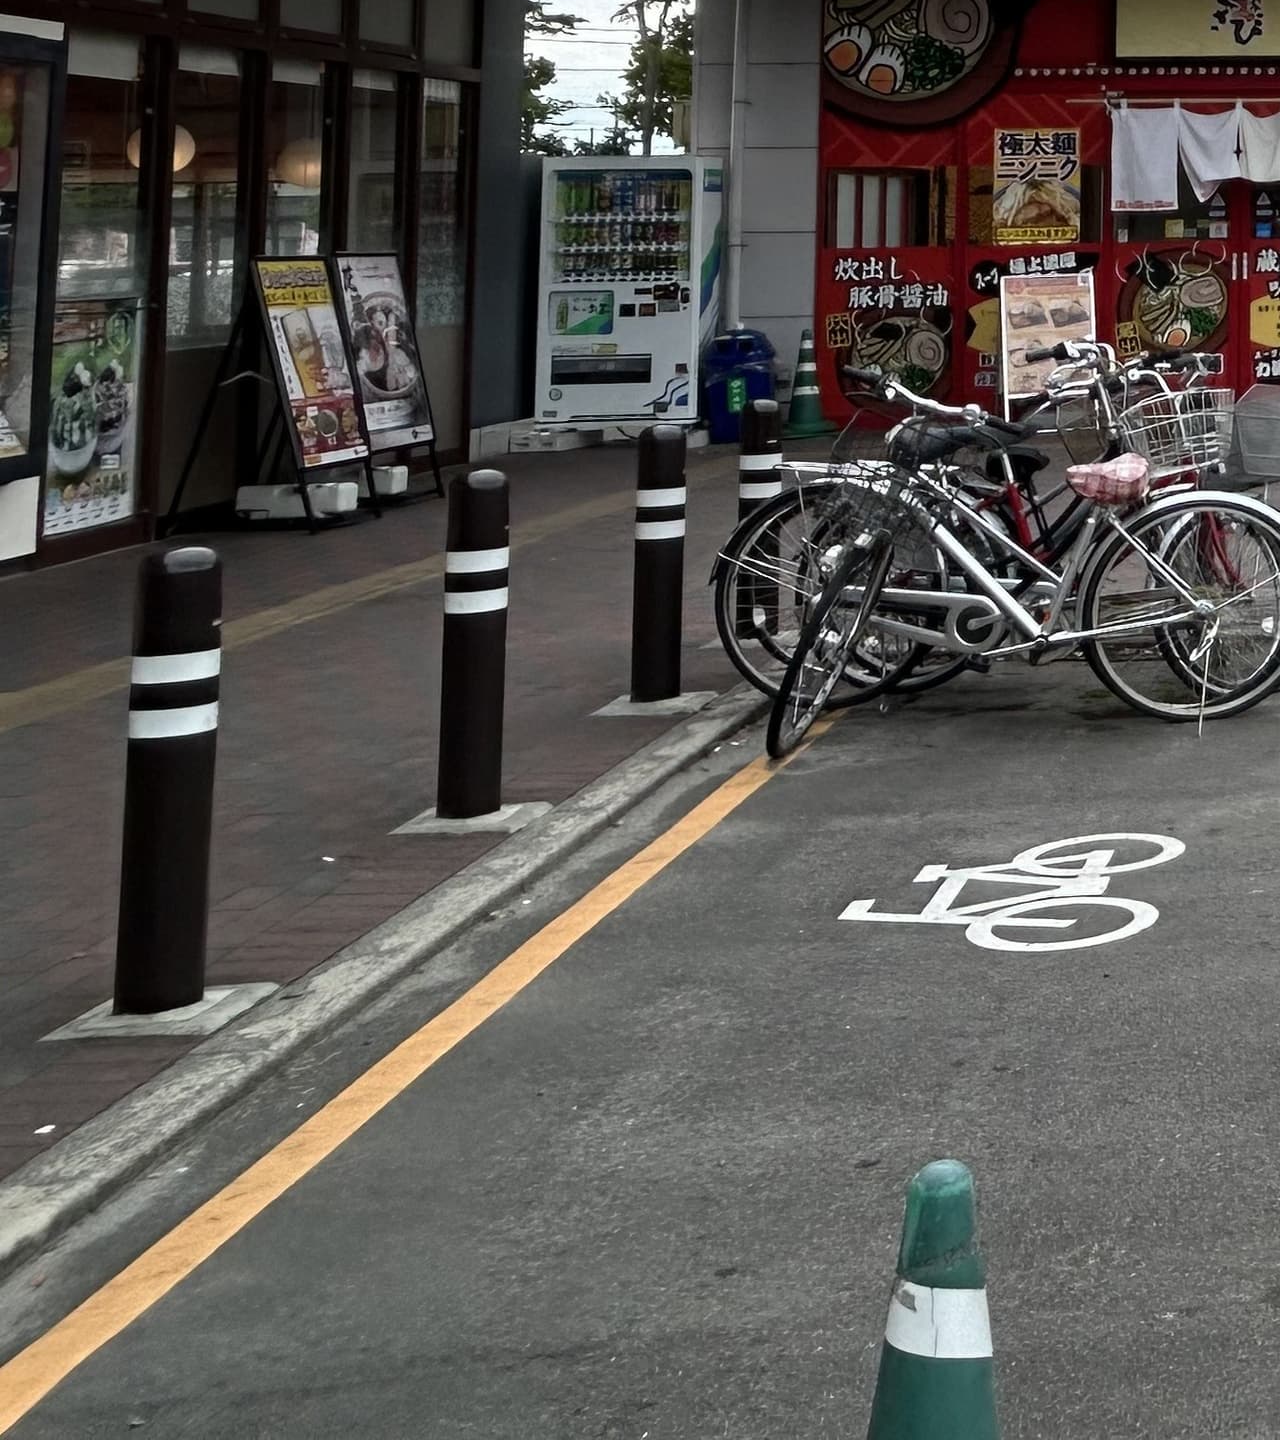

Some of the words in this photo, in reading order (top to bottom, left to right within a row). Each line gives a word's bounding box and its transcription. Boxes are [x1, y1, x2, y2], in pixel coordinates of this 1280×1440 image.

[998, 131, 1078, 156] 極太麺
[996, 157, 1079, 181] ニンニク
[834, 255, 904, 281] 炊出し
[848, 282, 949, 309] 豚骨醤油
